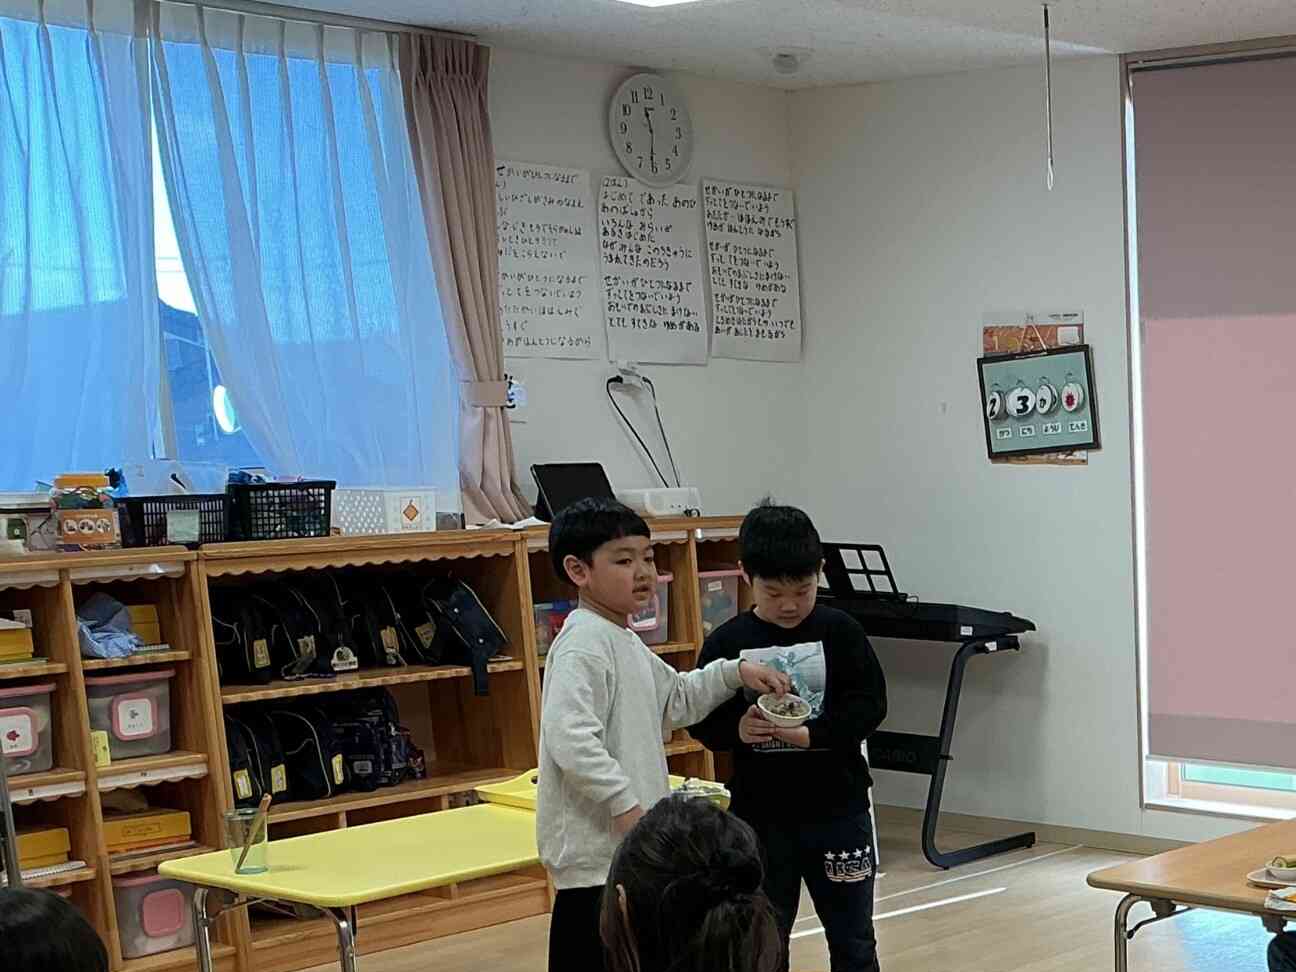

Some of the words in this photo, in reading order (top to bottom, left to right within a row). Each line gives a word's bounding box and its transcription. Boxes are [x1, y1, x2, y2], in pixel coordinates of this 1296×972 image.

[631, 90, 639, 103] 11
[643, 88, 653, 100] 12
[622, 103, 631, 116] 10
[670, 108, 677, 120] 2
[620, 122, 627, 134] 9
[675, 127, 682, 140] 3
[626, 143, 632, 153] 8
[672, 144, 679, 156] 4
[637, 156, 643, 168] 7
[665, 158, 671, 170] 5
[1016, 395, 1029, 414] 3
